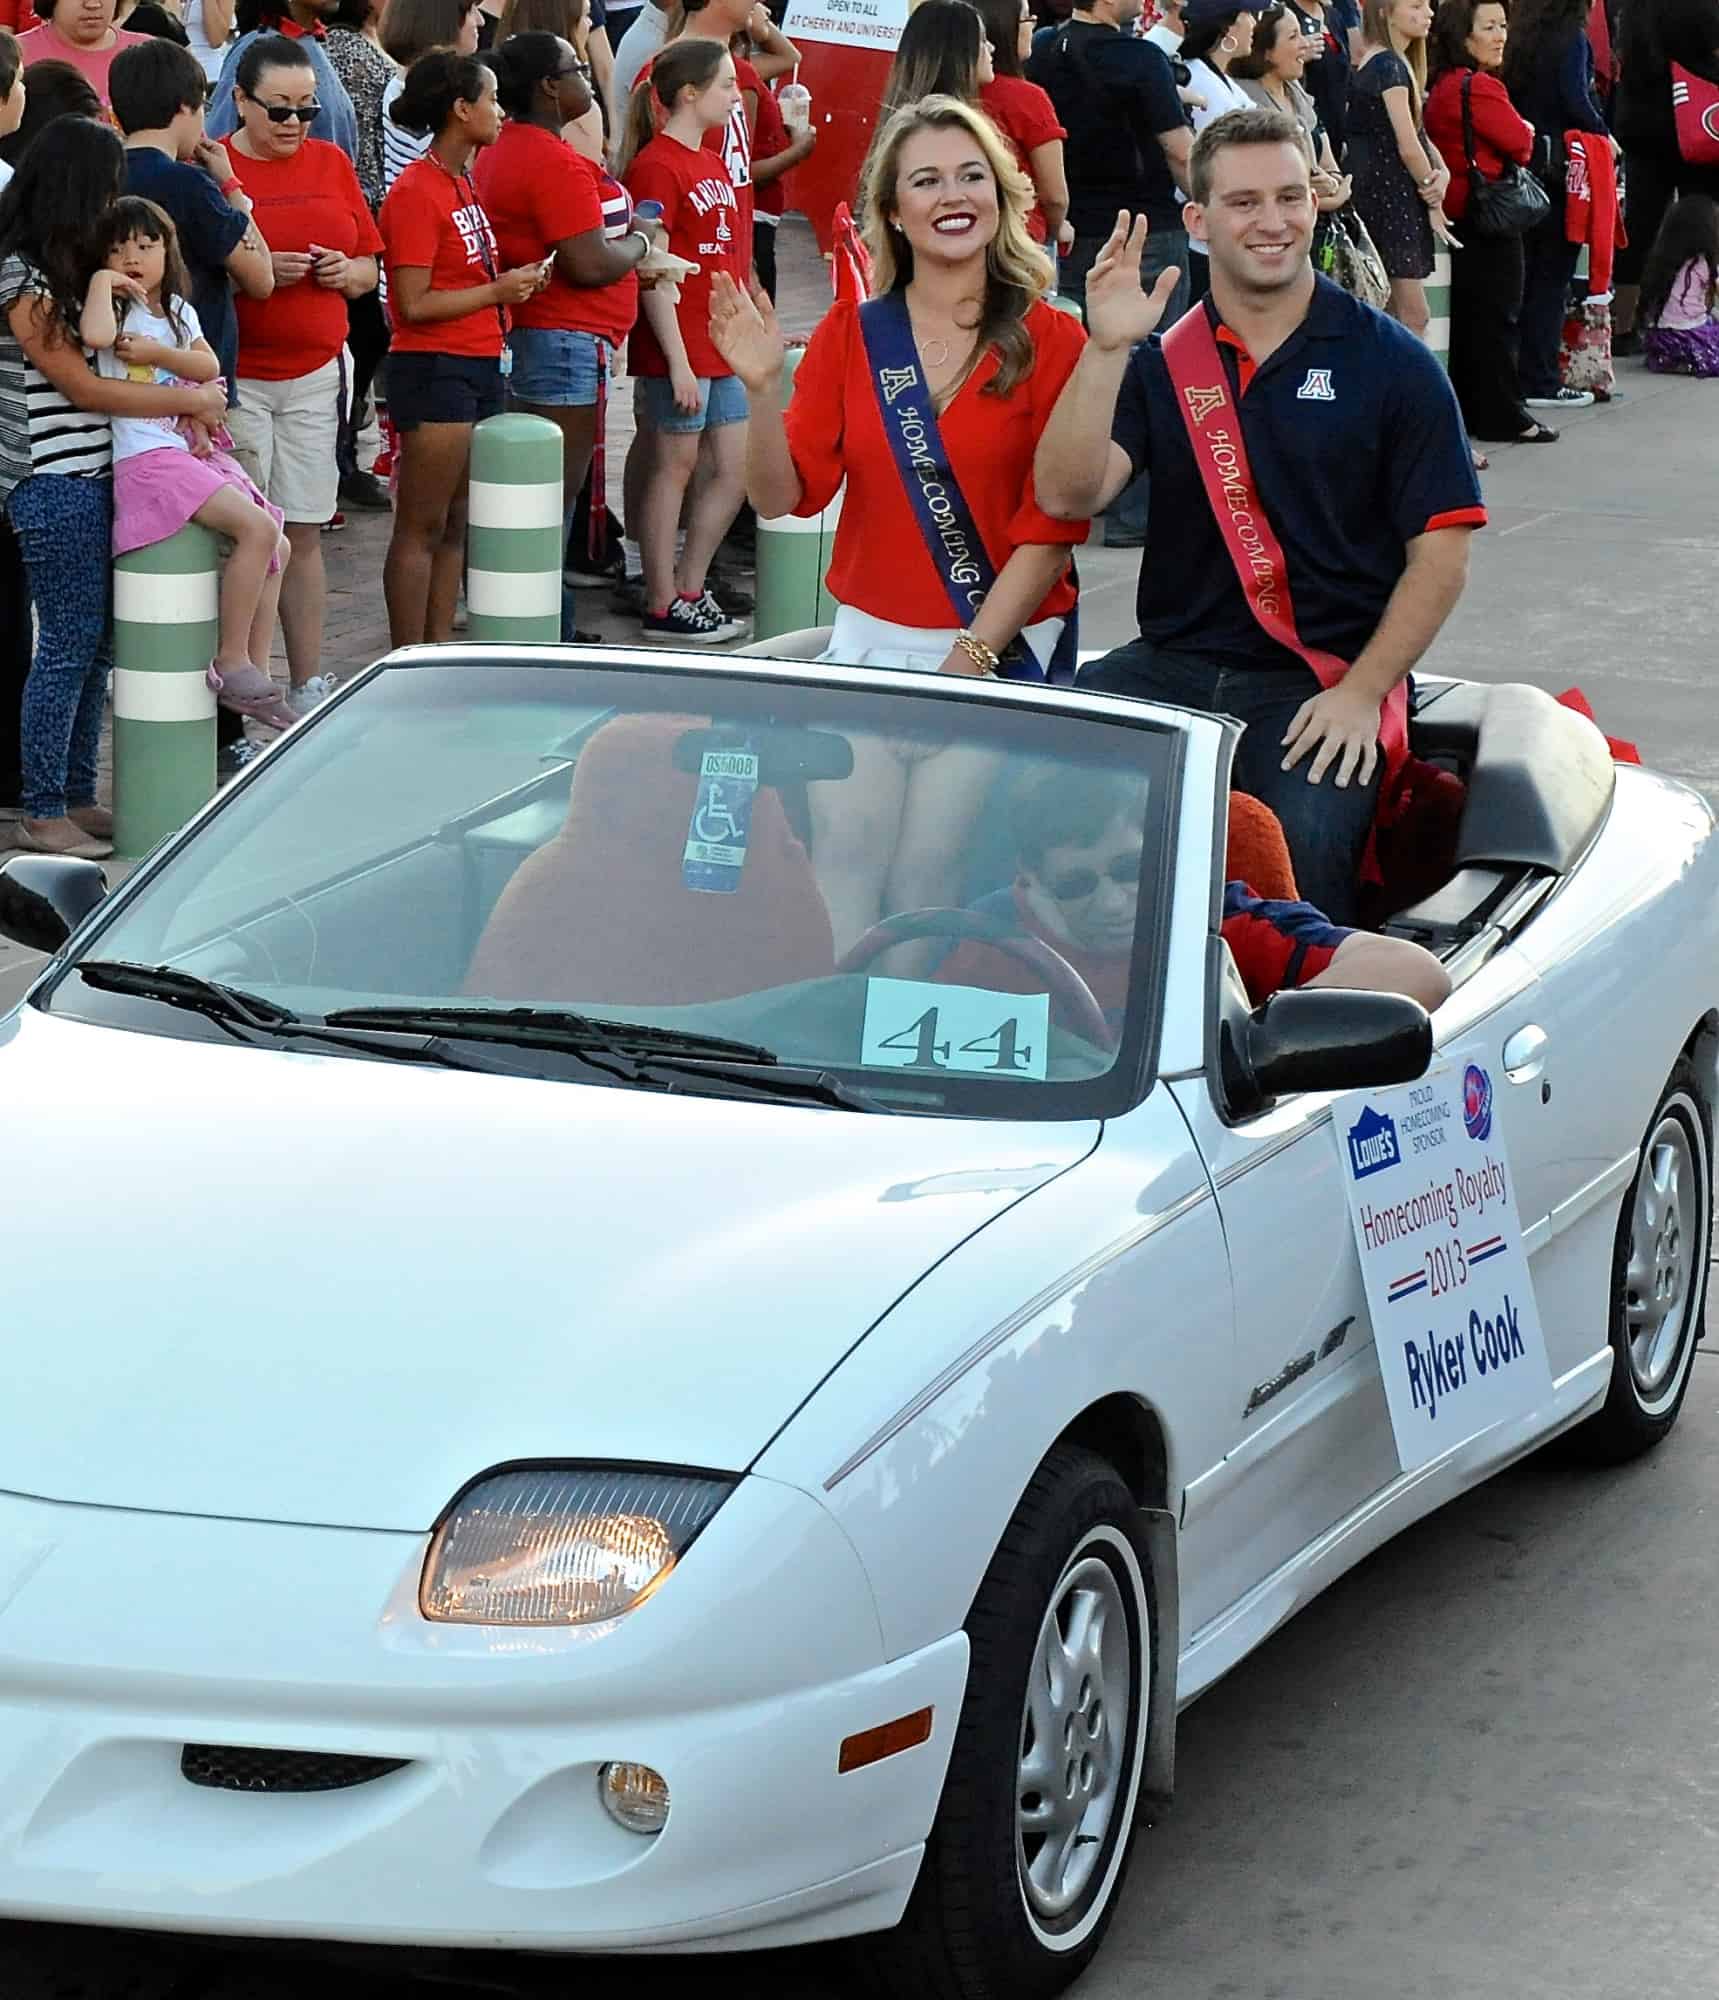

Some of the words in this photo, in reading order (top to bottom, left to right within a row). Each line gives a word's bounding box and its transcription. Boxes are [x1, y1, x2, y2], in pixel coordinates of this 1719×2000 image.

[790, 15, 802, 26] AT
[802, 16, 835, 31] CHERRY
[837, 19, 856, 34] AND
[856, 22, 903, 39] UNIVERSIT
[826, 0, 850, 12] OPEN
[851, 2, 863, 14] TO
[863, 4, 878, 16] ALL
[688, 178, 738, 217] ARIZON
[880, 364, 918, 404] A
[1297, 368, 1336, 400] A
[1184, 384, 1225, 426] A
[897, 406, 981, 584] HOMECOMING
[1206, 428, 1280, 615] HOMECOMING
[878, 1006, 1031, 1070] 44
[1409, 1086, 1433, 1108] PROUD
[1400, 1101, 1451, 1134] HOMECOMING
[1412, 1127, 1447, 1154] SPONSOR
[1360, 1180, 1459, 1250] Homecoming
[1455, 1156, 1507, 1215] Royalty
[1425, 1239, 1467, 1297] 2013
[1404, 1330, 1467, 1420] Ryker
[1469, 1294, 1525, 1376] Cook
